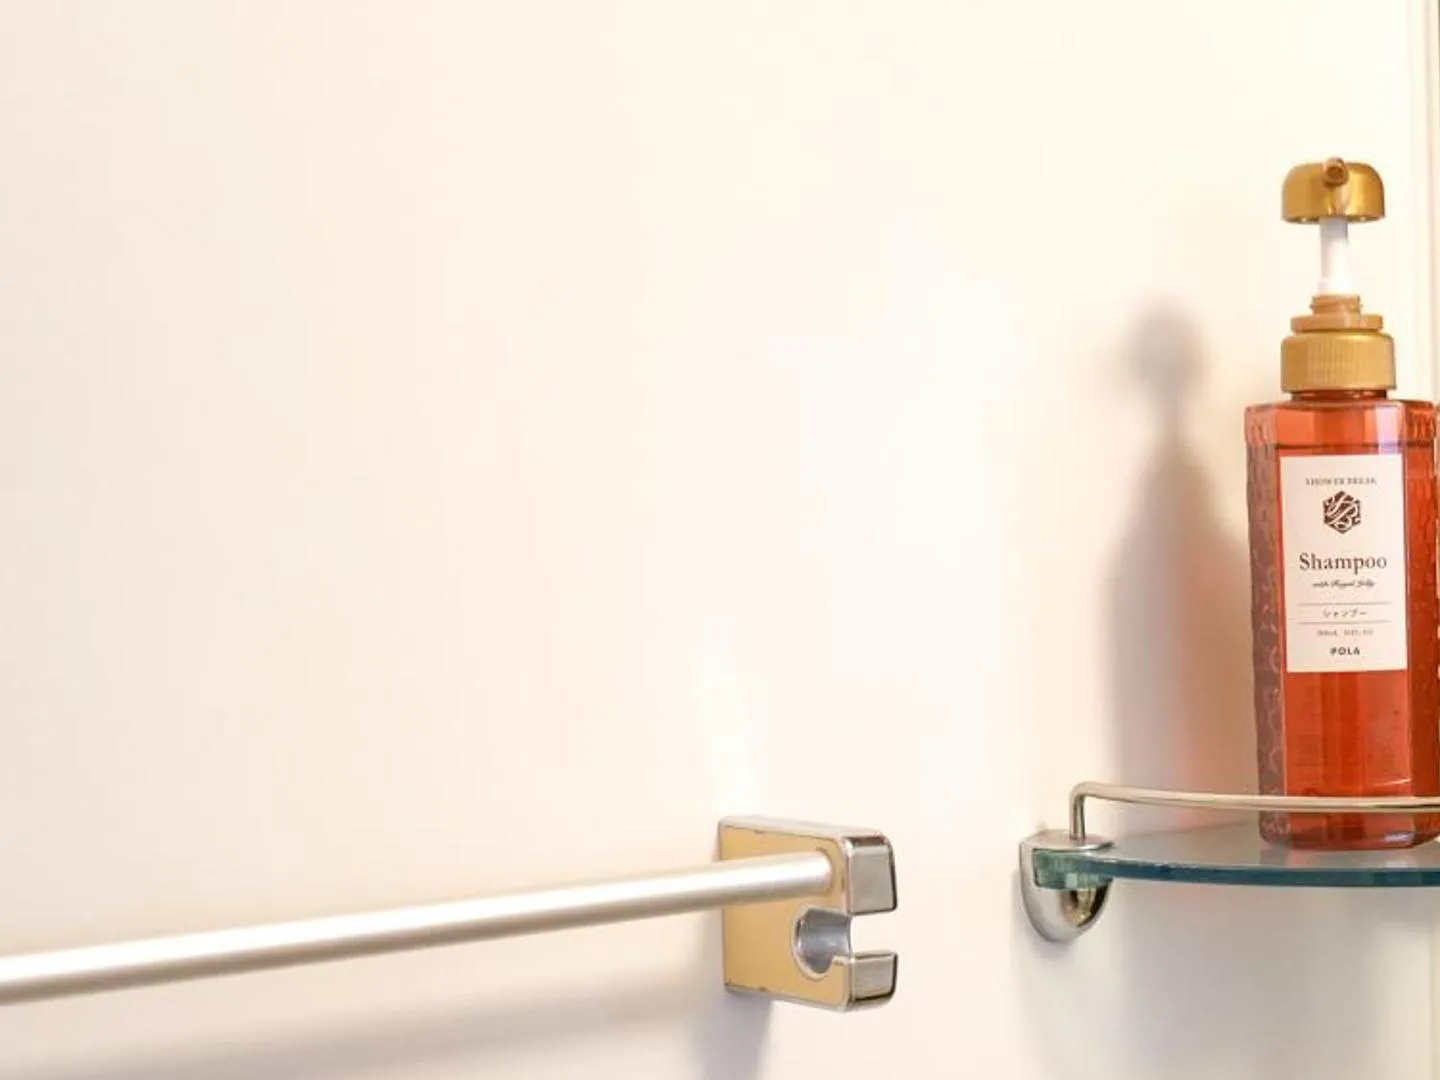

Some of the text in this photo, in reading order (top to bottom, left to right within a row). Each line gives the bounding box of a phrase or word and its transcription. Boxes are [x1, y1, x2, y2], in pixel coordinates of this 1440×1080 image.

[1299, 552, 1388, 575] Shampoo
[1323, 607, 1368, 618] シャンプー
[1330, 646, 1361, 656] POLA
